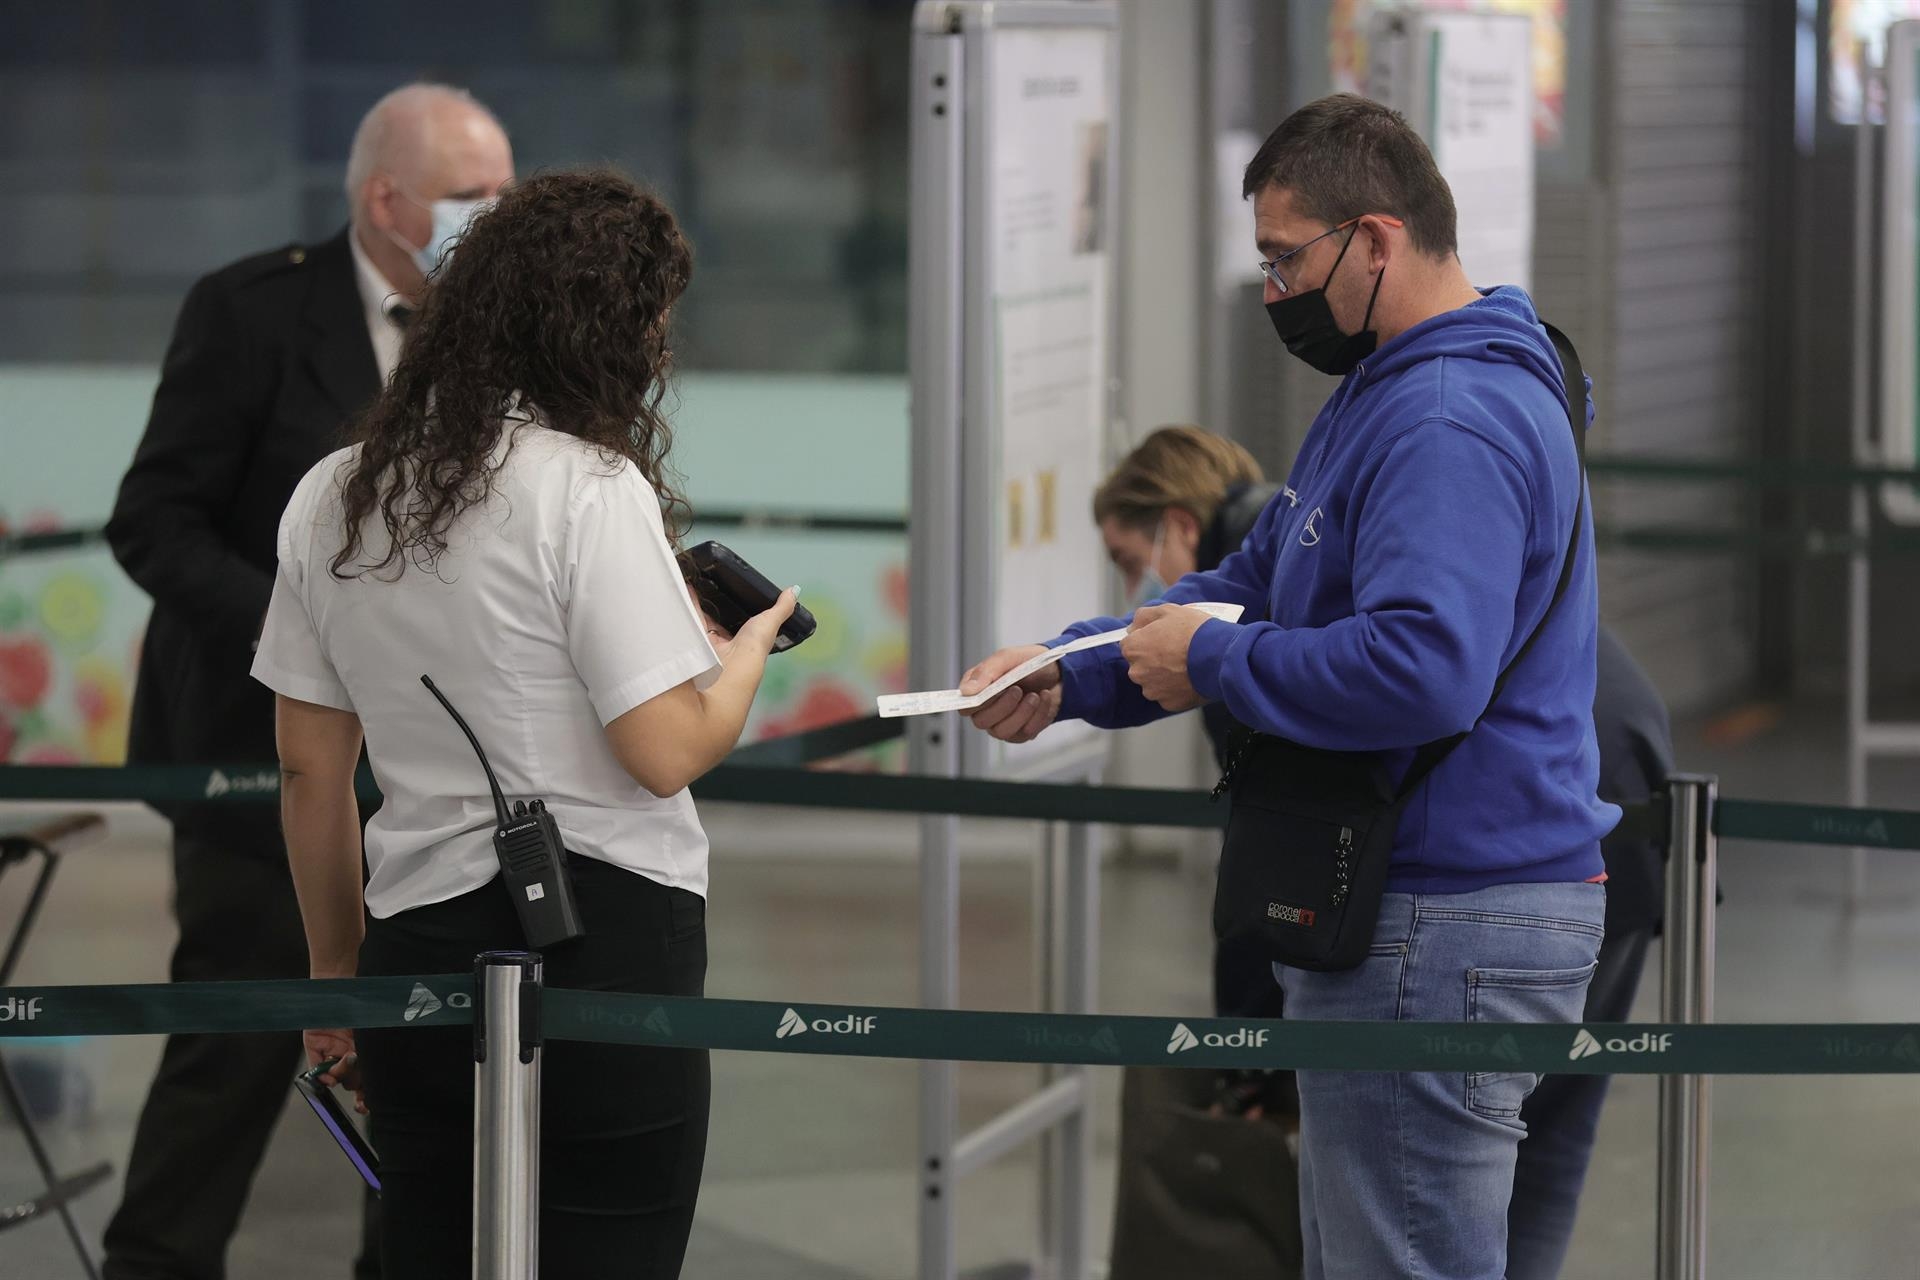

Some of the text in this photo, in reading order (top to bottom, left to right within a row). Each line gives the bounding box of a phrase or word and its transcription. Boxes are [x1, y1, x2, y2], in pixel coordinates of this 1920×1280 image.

[507, 821, 537, 834] MOTOROLA
[0, 997, 43, 1021] dif
[811, 1014, 877, 1034] adif
[1203, 1027, 1270, 1048] adif
[1605, 1032, 1674, 1053] adif
